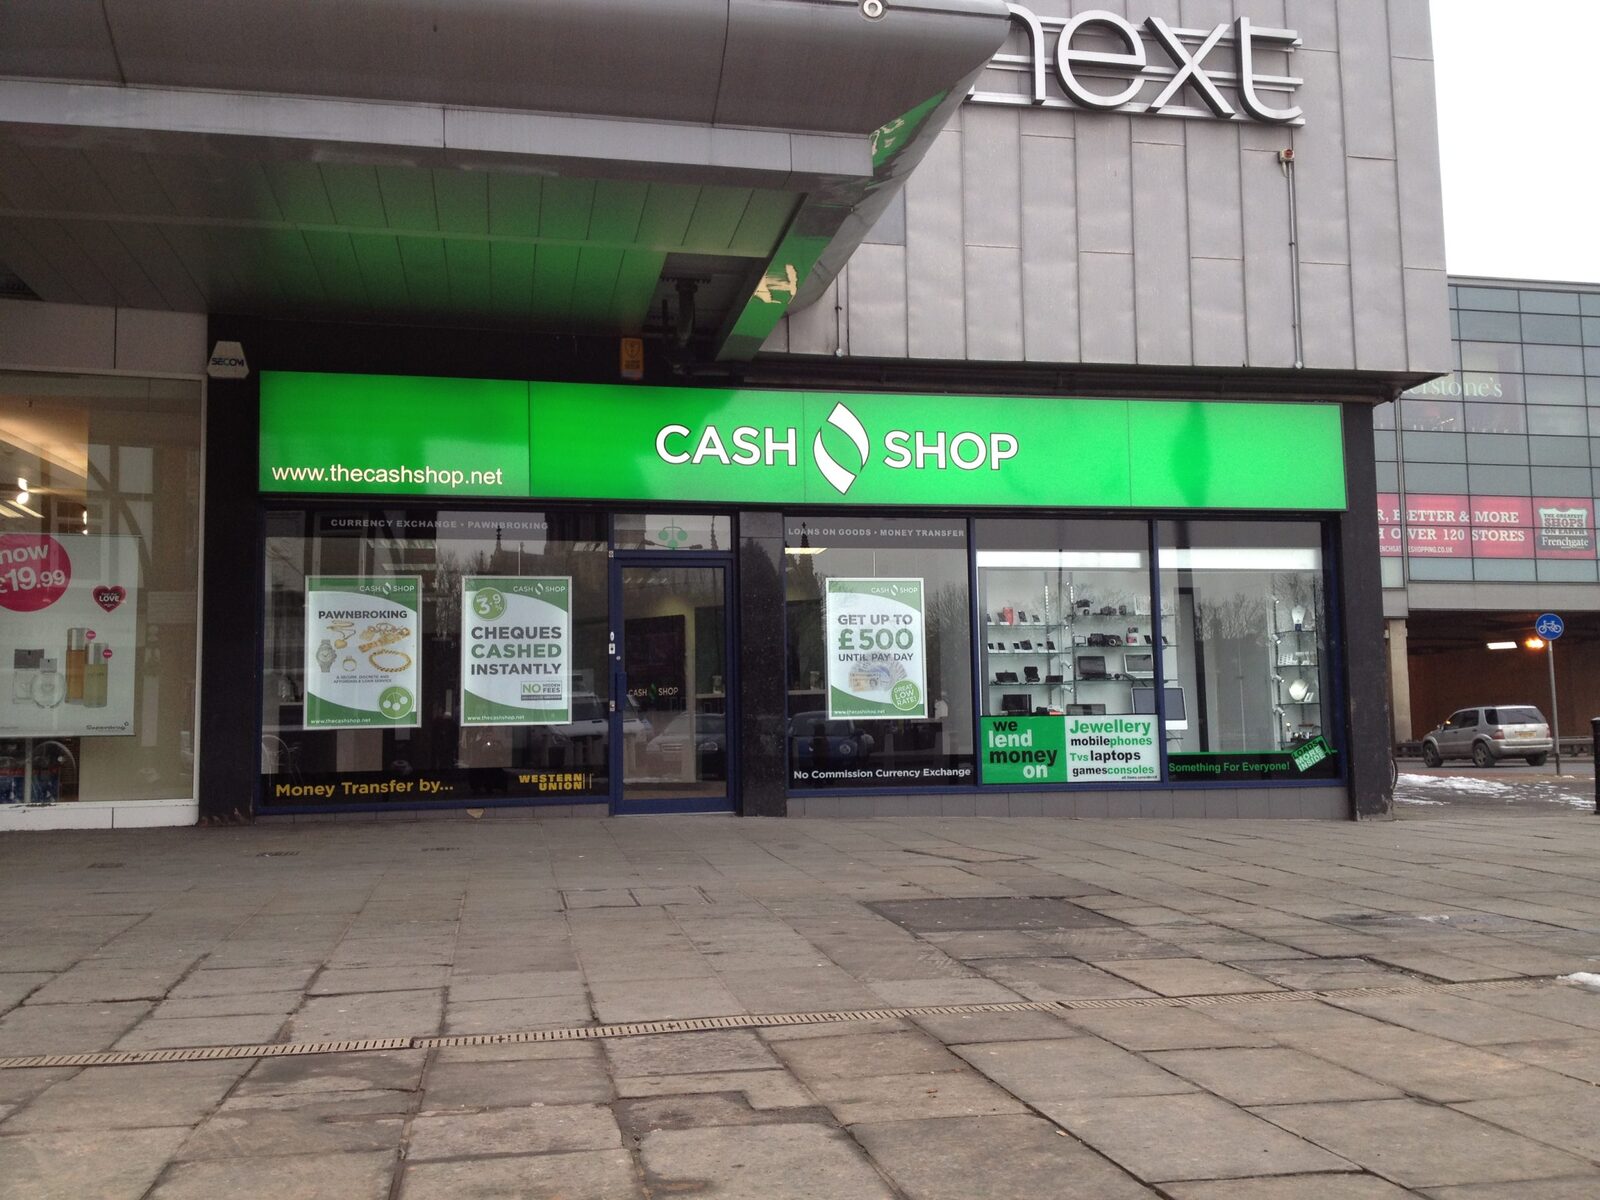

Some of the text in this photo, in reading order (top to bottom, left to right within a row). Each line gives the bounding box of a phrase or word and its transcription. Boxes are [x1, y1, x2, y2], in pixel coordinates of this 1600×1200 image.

[1007, 3, 1303, 122] next
[211, 357, 245, 367] SECOM
[1402, 377, 1503, 398] erstone's
[655, 424, 1019, 471] CASH SHOP
[272, 464, 503, 488] www.thecashshop.net
[1459, 510, 1470, 522] &
[1475, 511, 1519, 523] MORE
[1544, 518, 1584, 527] SHOPS
[331, 518, 548, 530] CURRENCY EXCHANGE PAWNBROKING
[788, 528, 965, 537] LOANS ON GOODS MONEY TRANSFER
[1391, 527, 1438, 540] OVER
[1443, 528, 1465, 541] 120
[1471, 529, 1525, 542] STORES
[1542, 537, 1588, 547] Frenchgate
[0, 545, 48, 565] now
[318, 610, 408, 619] PAWNBROKING
[838, 614, 913, 625] GET UP TO
[471, 626, 562, 640] CHEQUES
[838, 628, 914, 650] £500
[471, 643, 562, 659] CASHED
[838, 653, 914, 662] UNTIL PAY DAY
[471, 663, 562, 675] INSTANTLY
[522, 683, 541, 693] NO
[628, 687, 679, 697] CASH SHOP
[895, 689, 914, 700] LOW
[993, 720, 1018, 731] we
[1069, 719, 1151, 736] Jewellery
[988, 729, 1033, 748] lend
[1292, 740, 1319, 759] LOADS
[1294, 745, 1323, 764] MORE
[989, 749, 1058, 766] money
[1298, 752, 1327, 772] INSIDE
[794, 767, 971, 779] No Commission Currency Exchange
[1023, 764, 1048, 778] on
[1168, 762, 1290, 773] Something For Everyone!
[519, 773, 582, 783] WESTERN
[275, 779, 454, 797] Money Transfer by...
[538, 781, 582, 791] UNION
